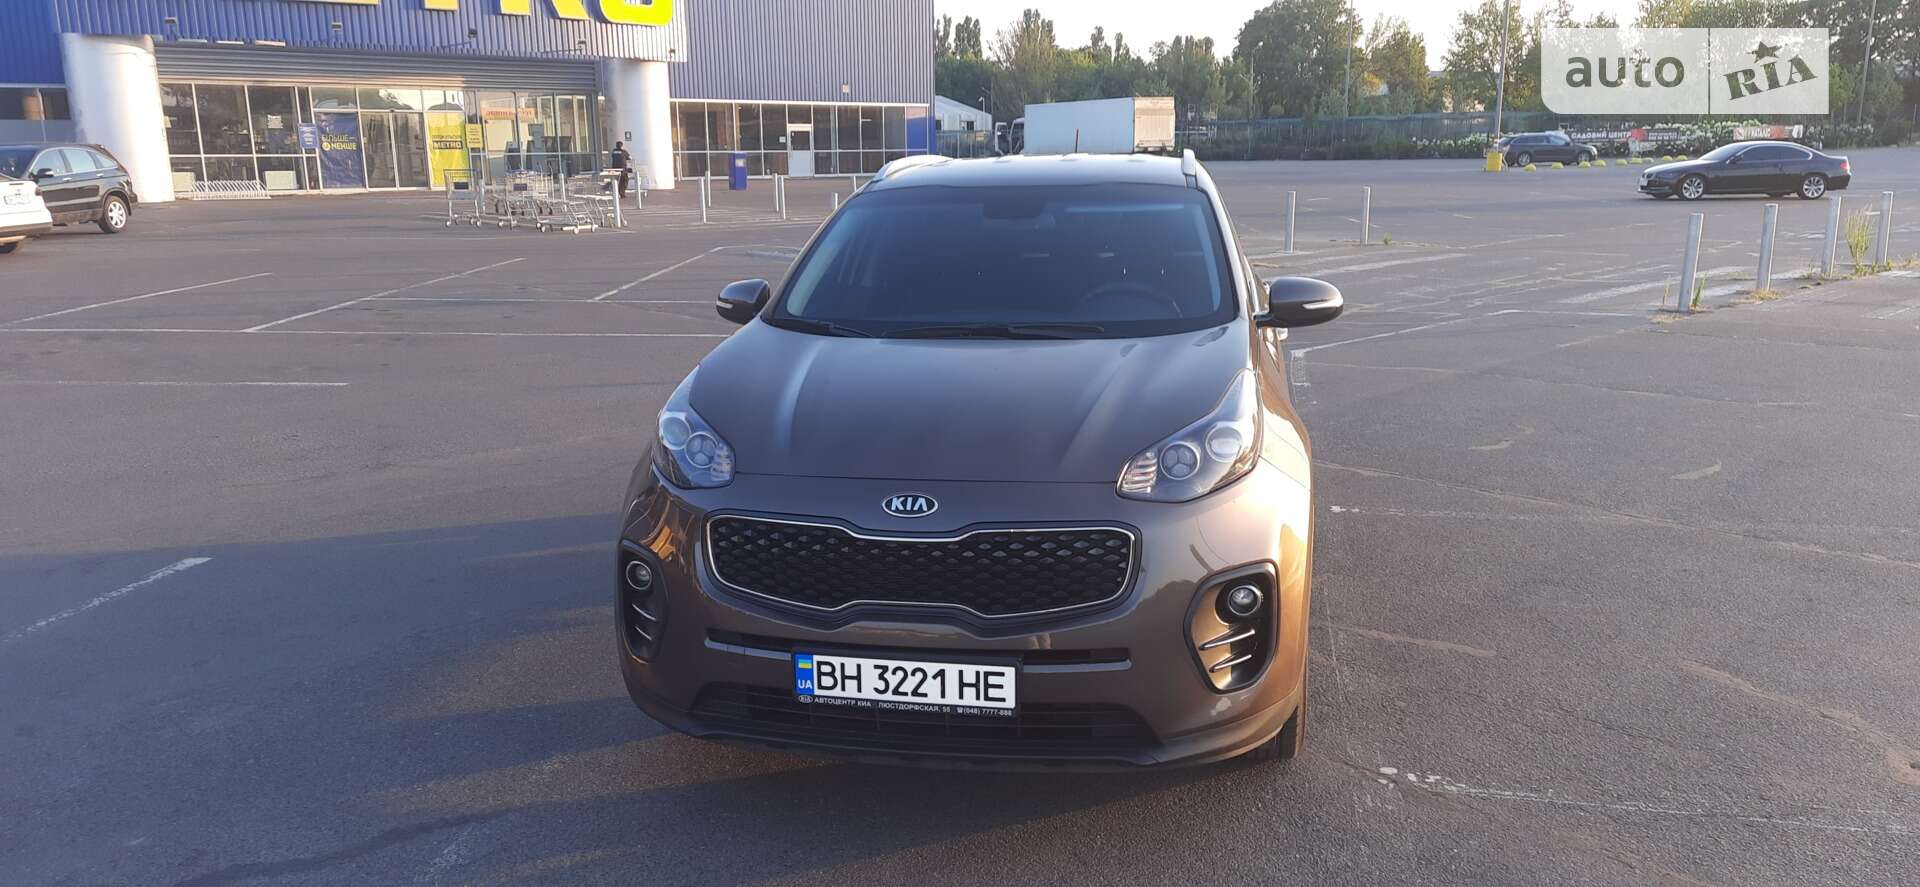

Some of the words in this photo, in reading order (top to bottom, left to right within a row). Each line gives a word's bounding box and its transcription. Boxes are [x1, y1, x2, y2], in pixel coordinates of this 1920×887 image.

[1608, 131, 1632, 139] ЦЕНТР
[433, 141, 462, 149] METRO
[891, 496, 928, 511] KIA
[798, 679, 812, 690] UA
[873, 664, 946, 699] 3221
[814, 697, 855, 706] АВТОЦЕНТР
